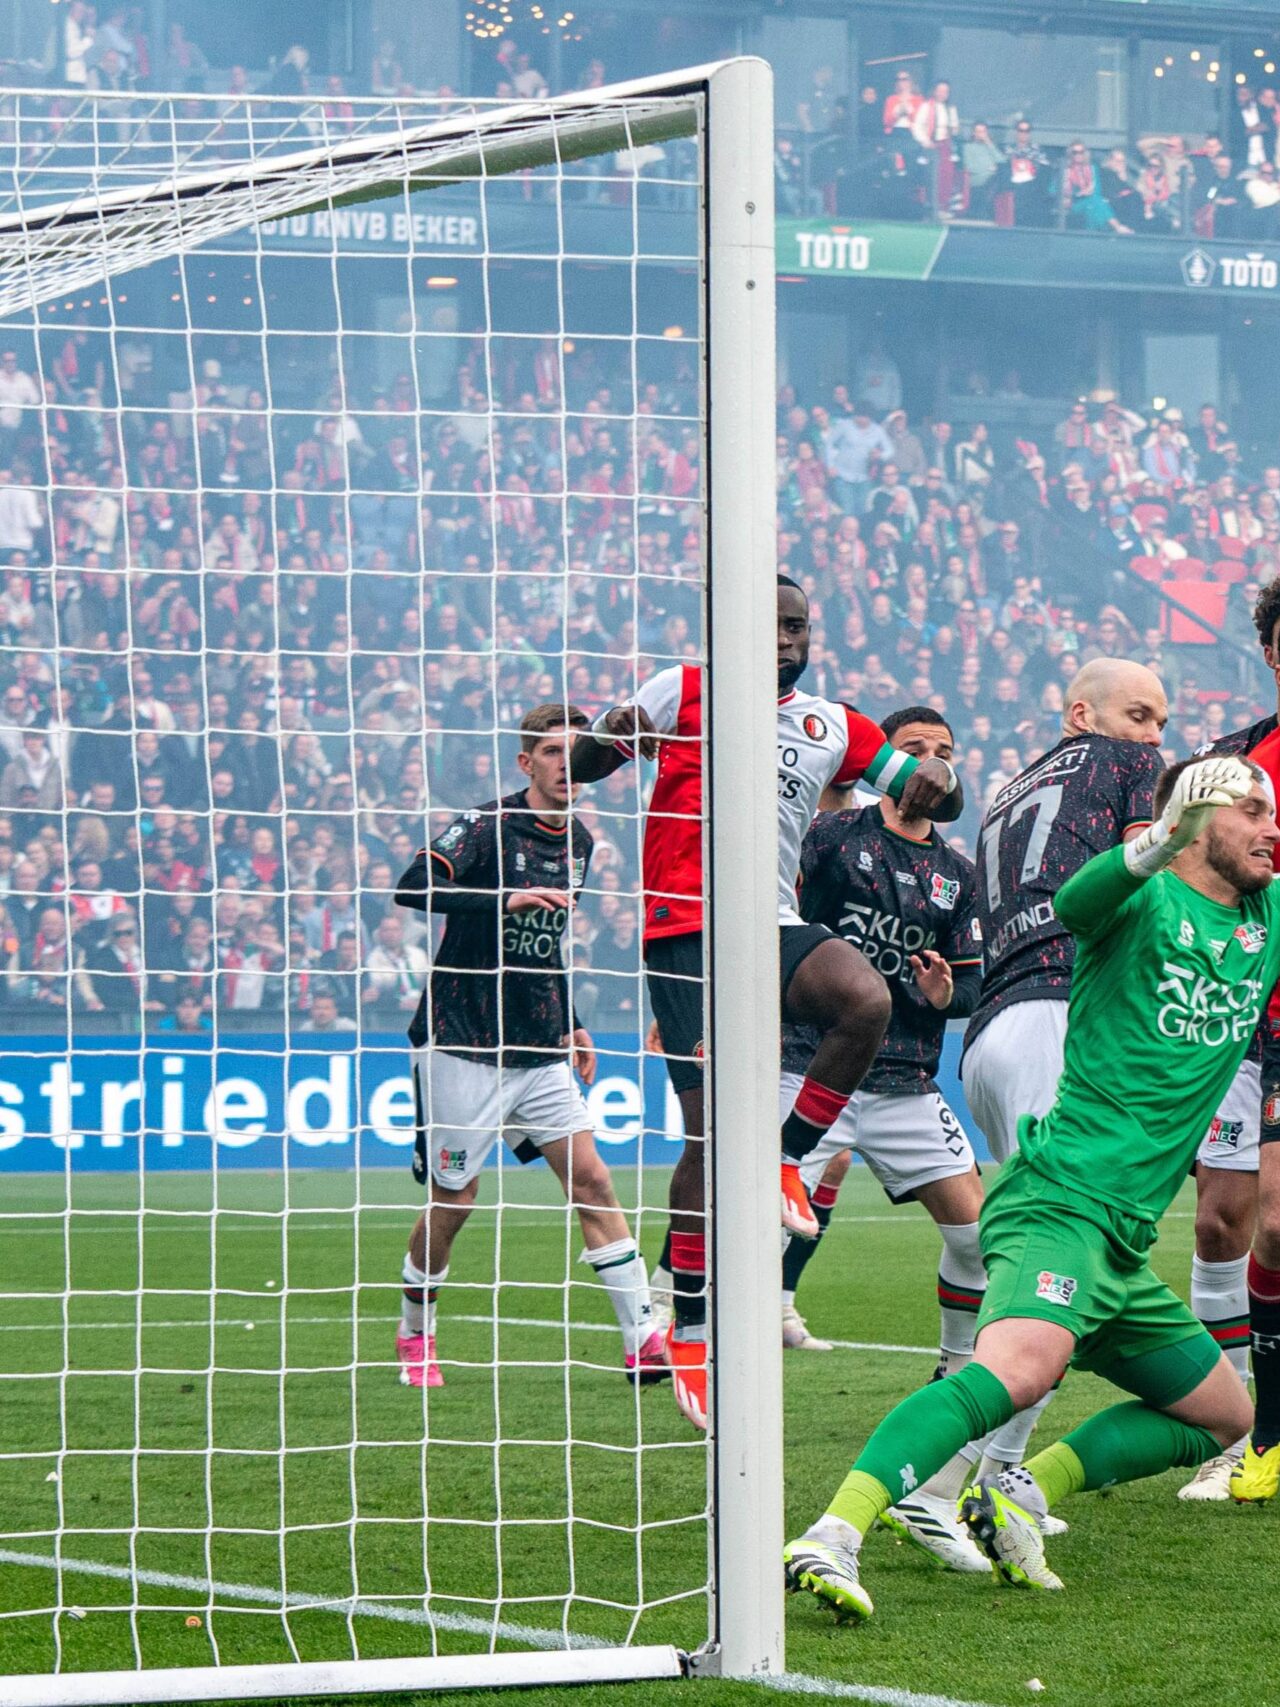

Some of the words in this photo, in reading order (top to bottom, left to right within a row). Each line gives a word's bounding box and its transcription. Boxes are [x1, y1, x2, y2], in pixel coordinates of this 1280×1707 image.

[313, 210, 388, 241] KNVB
[392, 213, 478, 246] BEKER
[795, 231, 870, 270] TOTO
[1220, 254, 1278, 288] TOTO
[982, 783, 1064, 914] 17
[503, 927, 561, 959] GRO
[987, 898, 1056, 960] NUTINC
